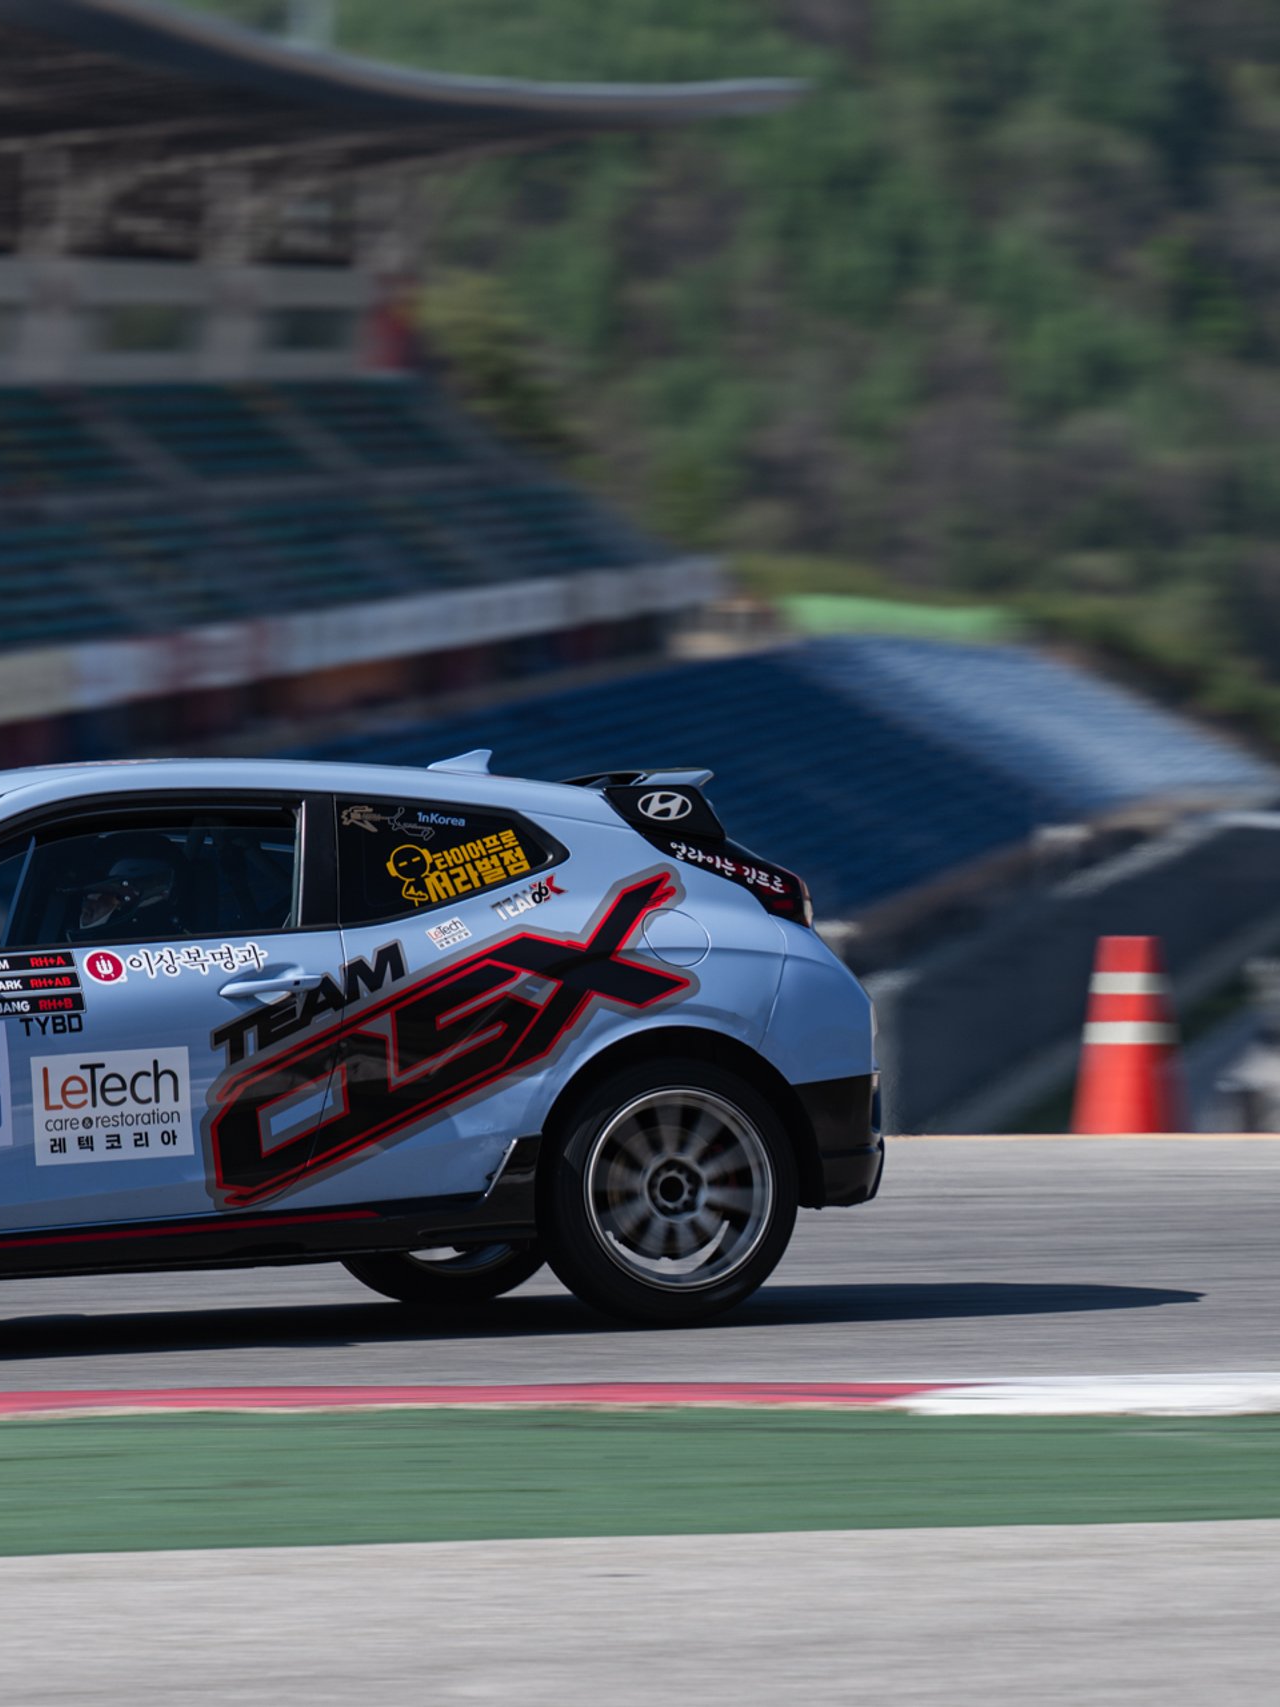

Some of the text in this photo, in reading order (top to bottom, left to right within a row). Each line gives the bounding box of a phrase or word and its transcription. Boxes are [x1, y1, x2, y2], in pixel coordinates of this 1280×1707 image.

[431, 829, 520, 871] 타이어프로
[424, 846, 531, 903] 서라벌점
[742, 866, 785, 893] 김프로
[428, 919, 464, 941] LeTech
[29, 957, 66, 968] RH+A
[129, 944, 265, 976] 이상복명과
[29, 976, 72, 989] RH+AB
[38, 997, 73, 1010] RH+B
[214, 942, 406, 1064] TEAM
[42, 1059, 180, 1111] LeTech
